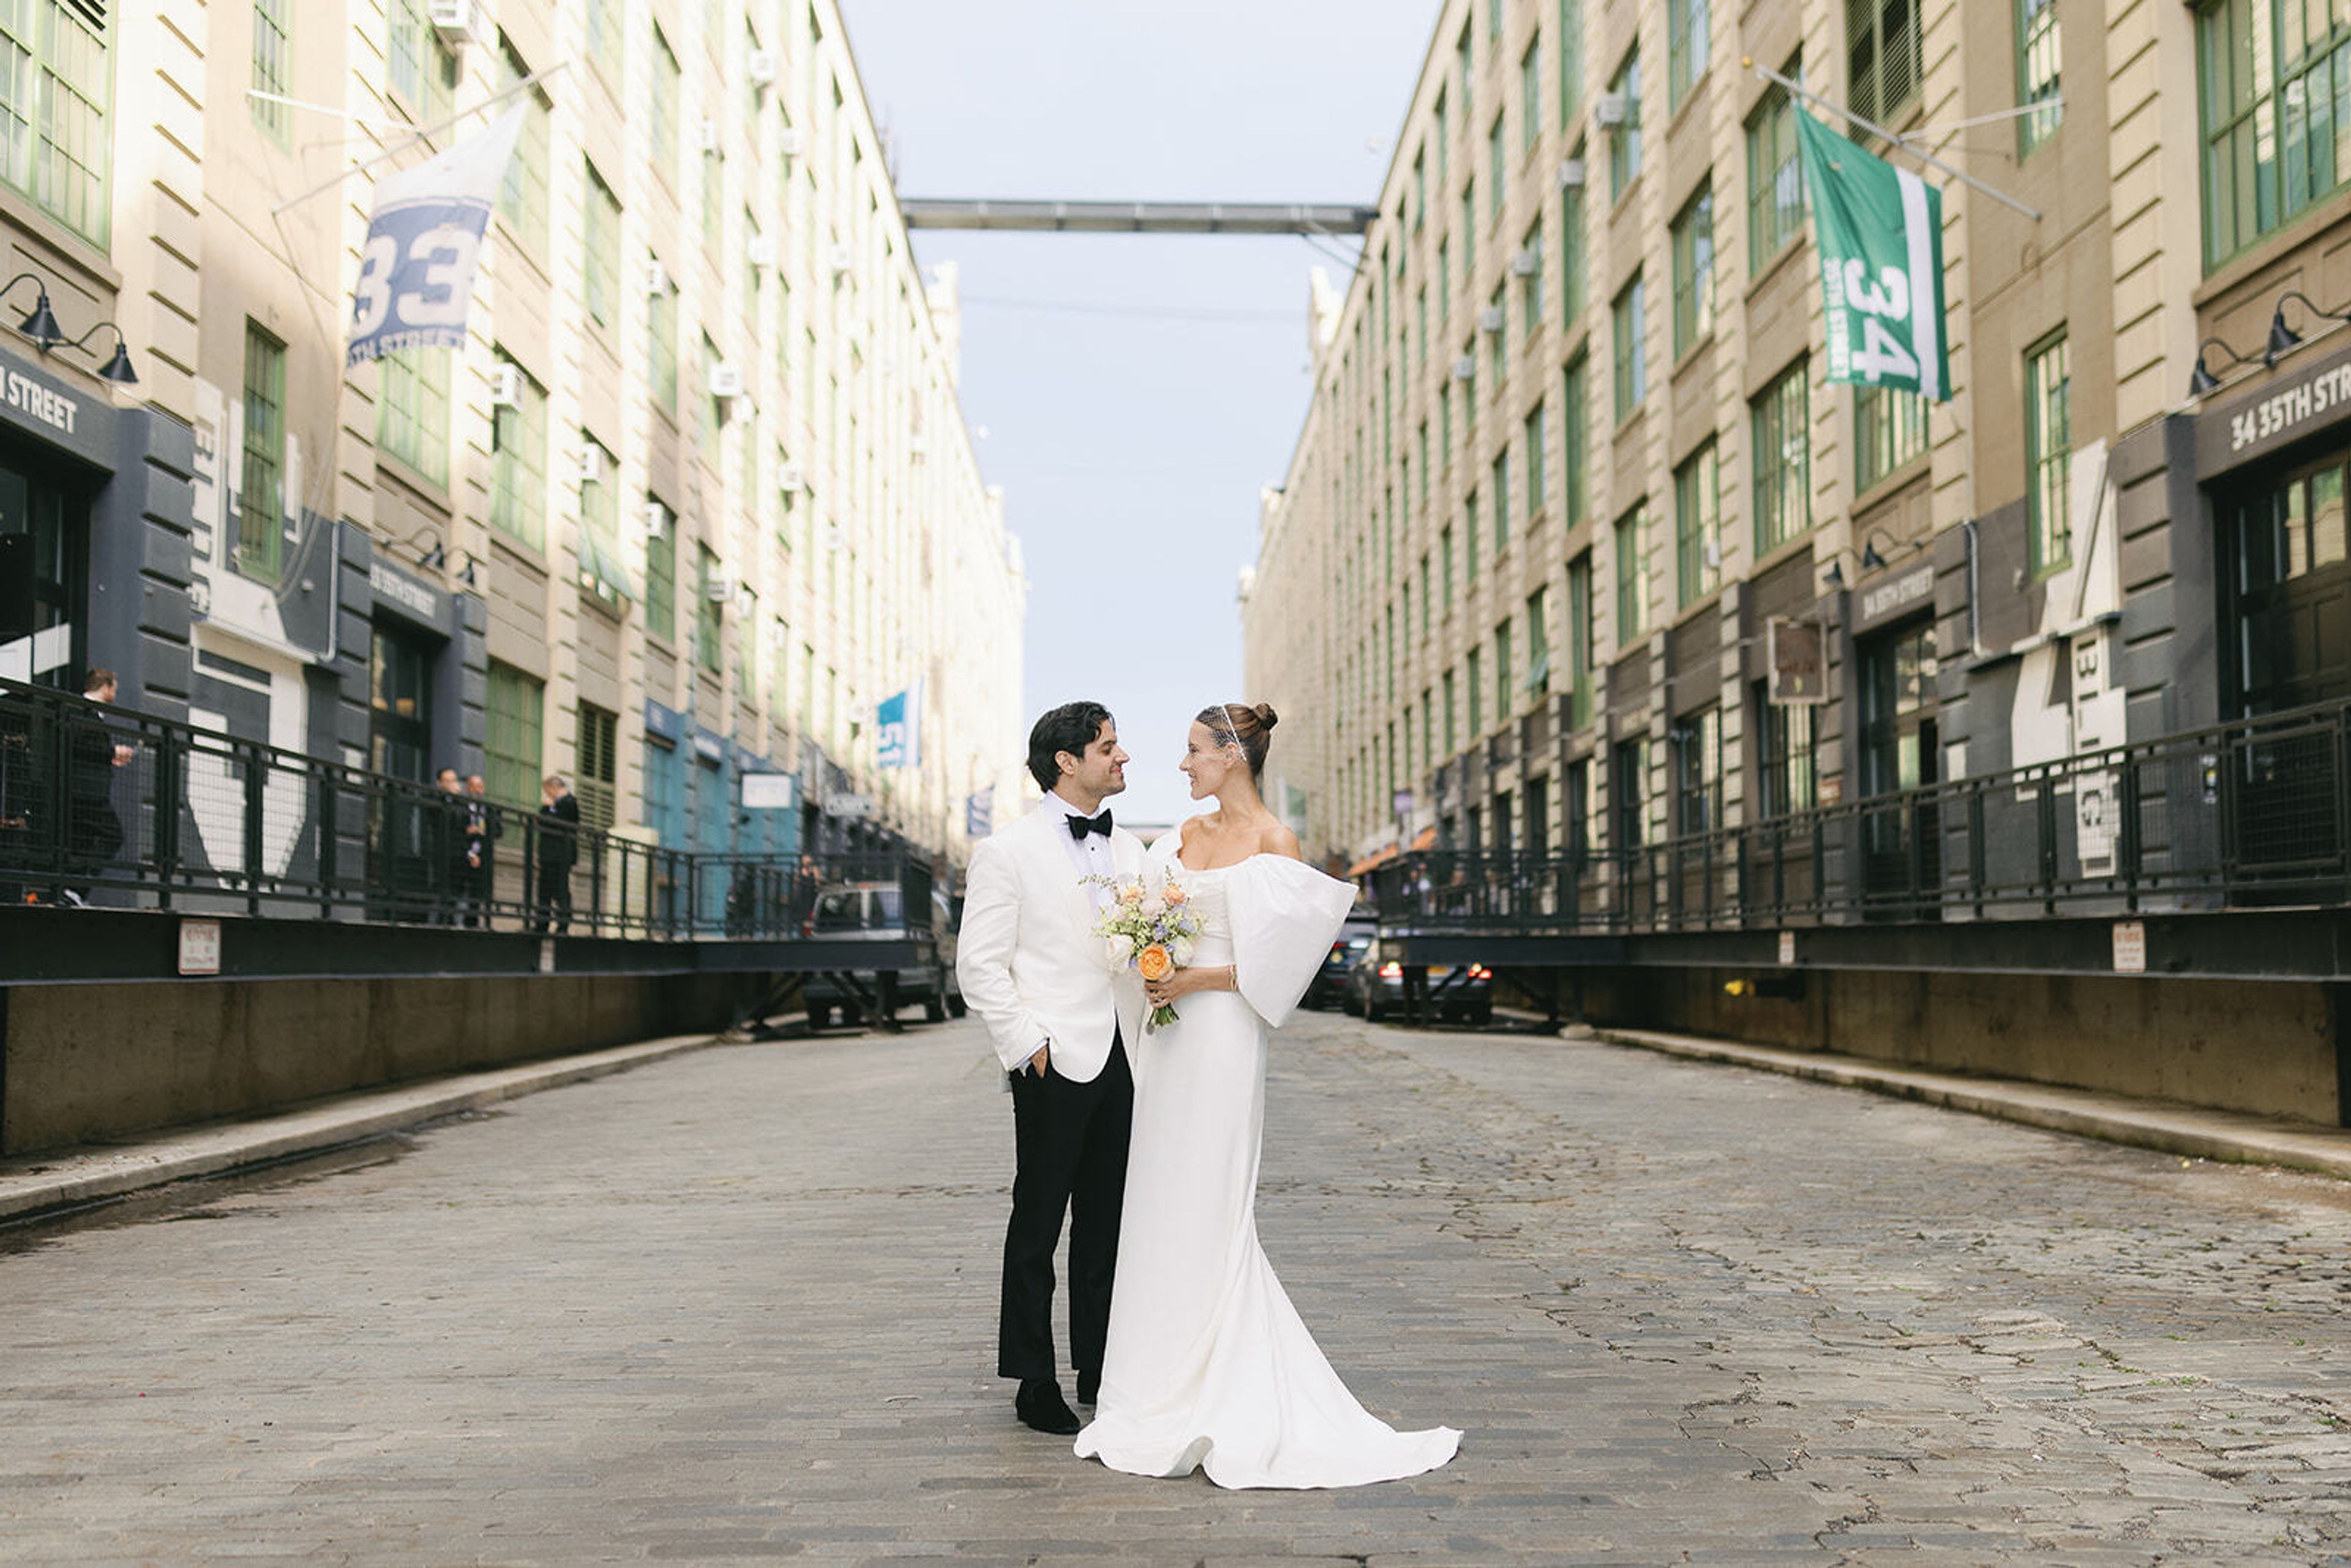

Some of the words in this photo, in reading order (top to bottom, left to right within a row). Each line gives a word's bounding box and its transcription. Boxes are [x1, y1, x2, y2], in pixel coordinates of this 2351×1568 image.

[1844, 258, 1918, 382] 34
[8, 371, 77, 434] STREET
[2232, 408, 2256, 451] 34
[2259, 382, 2311, 438] 35TH
